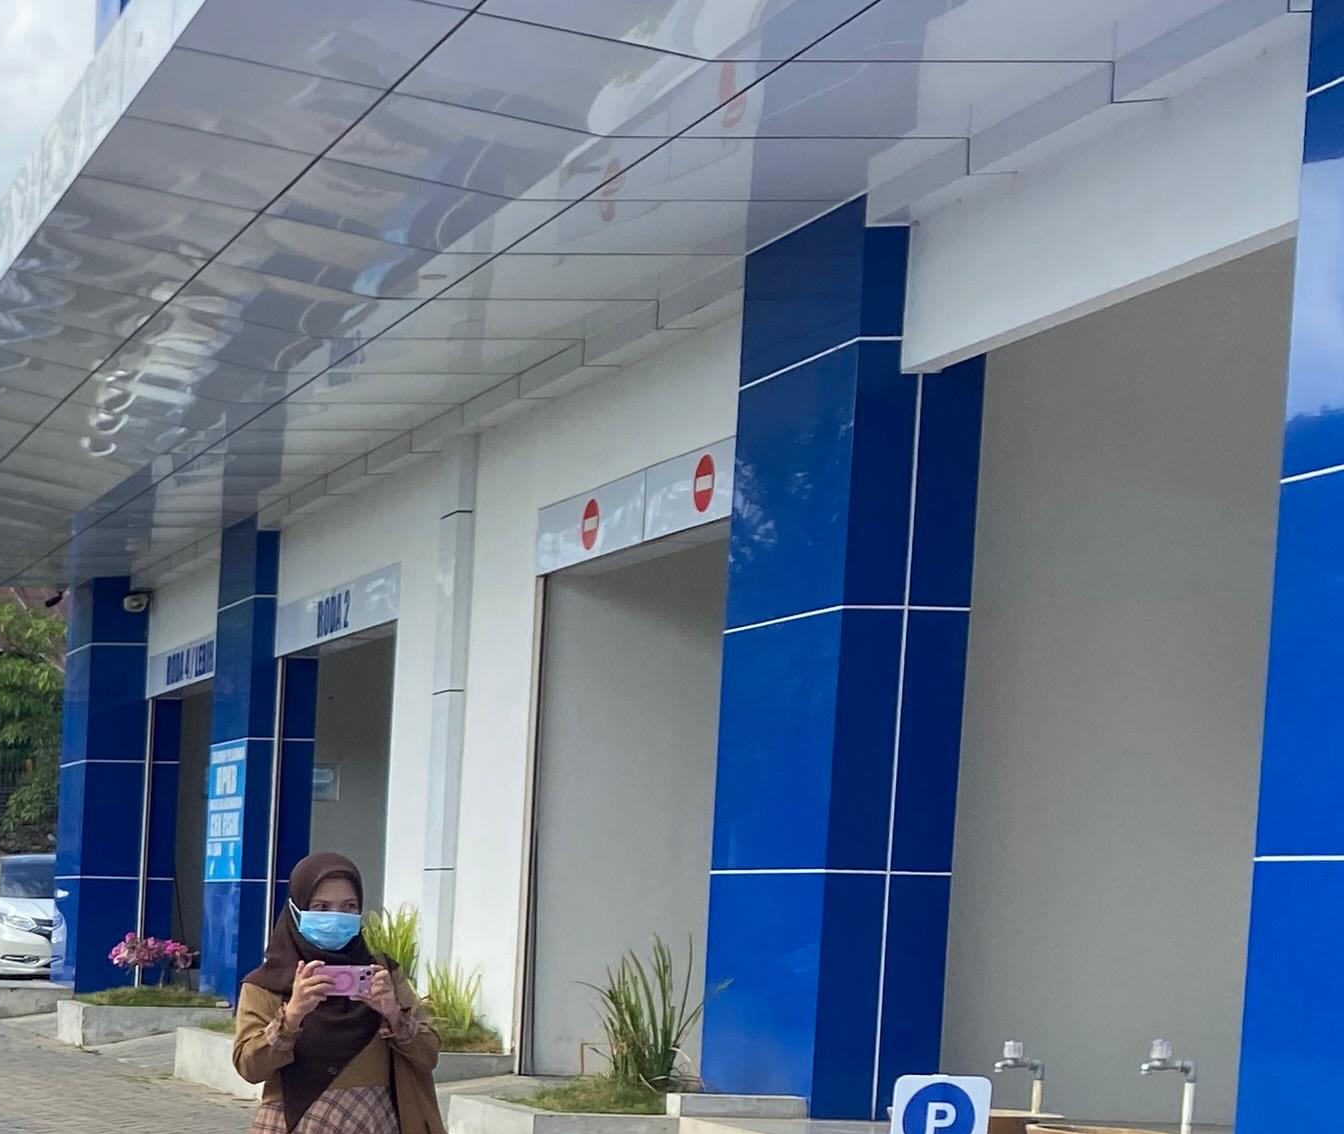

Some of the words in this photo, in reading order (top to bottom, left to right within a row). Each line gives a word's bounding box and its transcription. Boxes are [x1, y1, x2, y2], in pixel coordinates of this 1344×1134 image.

[317, 592, 342, 639] RODA
[343, 589, 352, 628] 2
[166, 650, 184, 685] RODA
